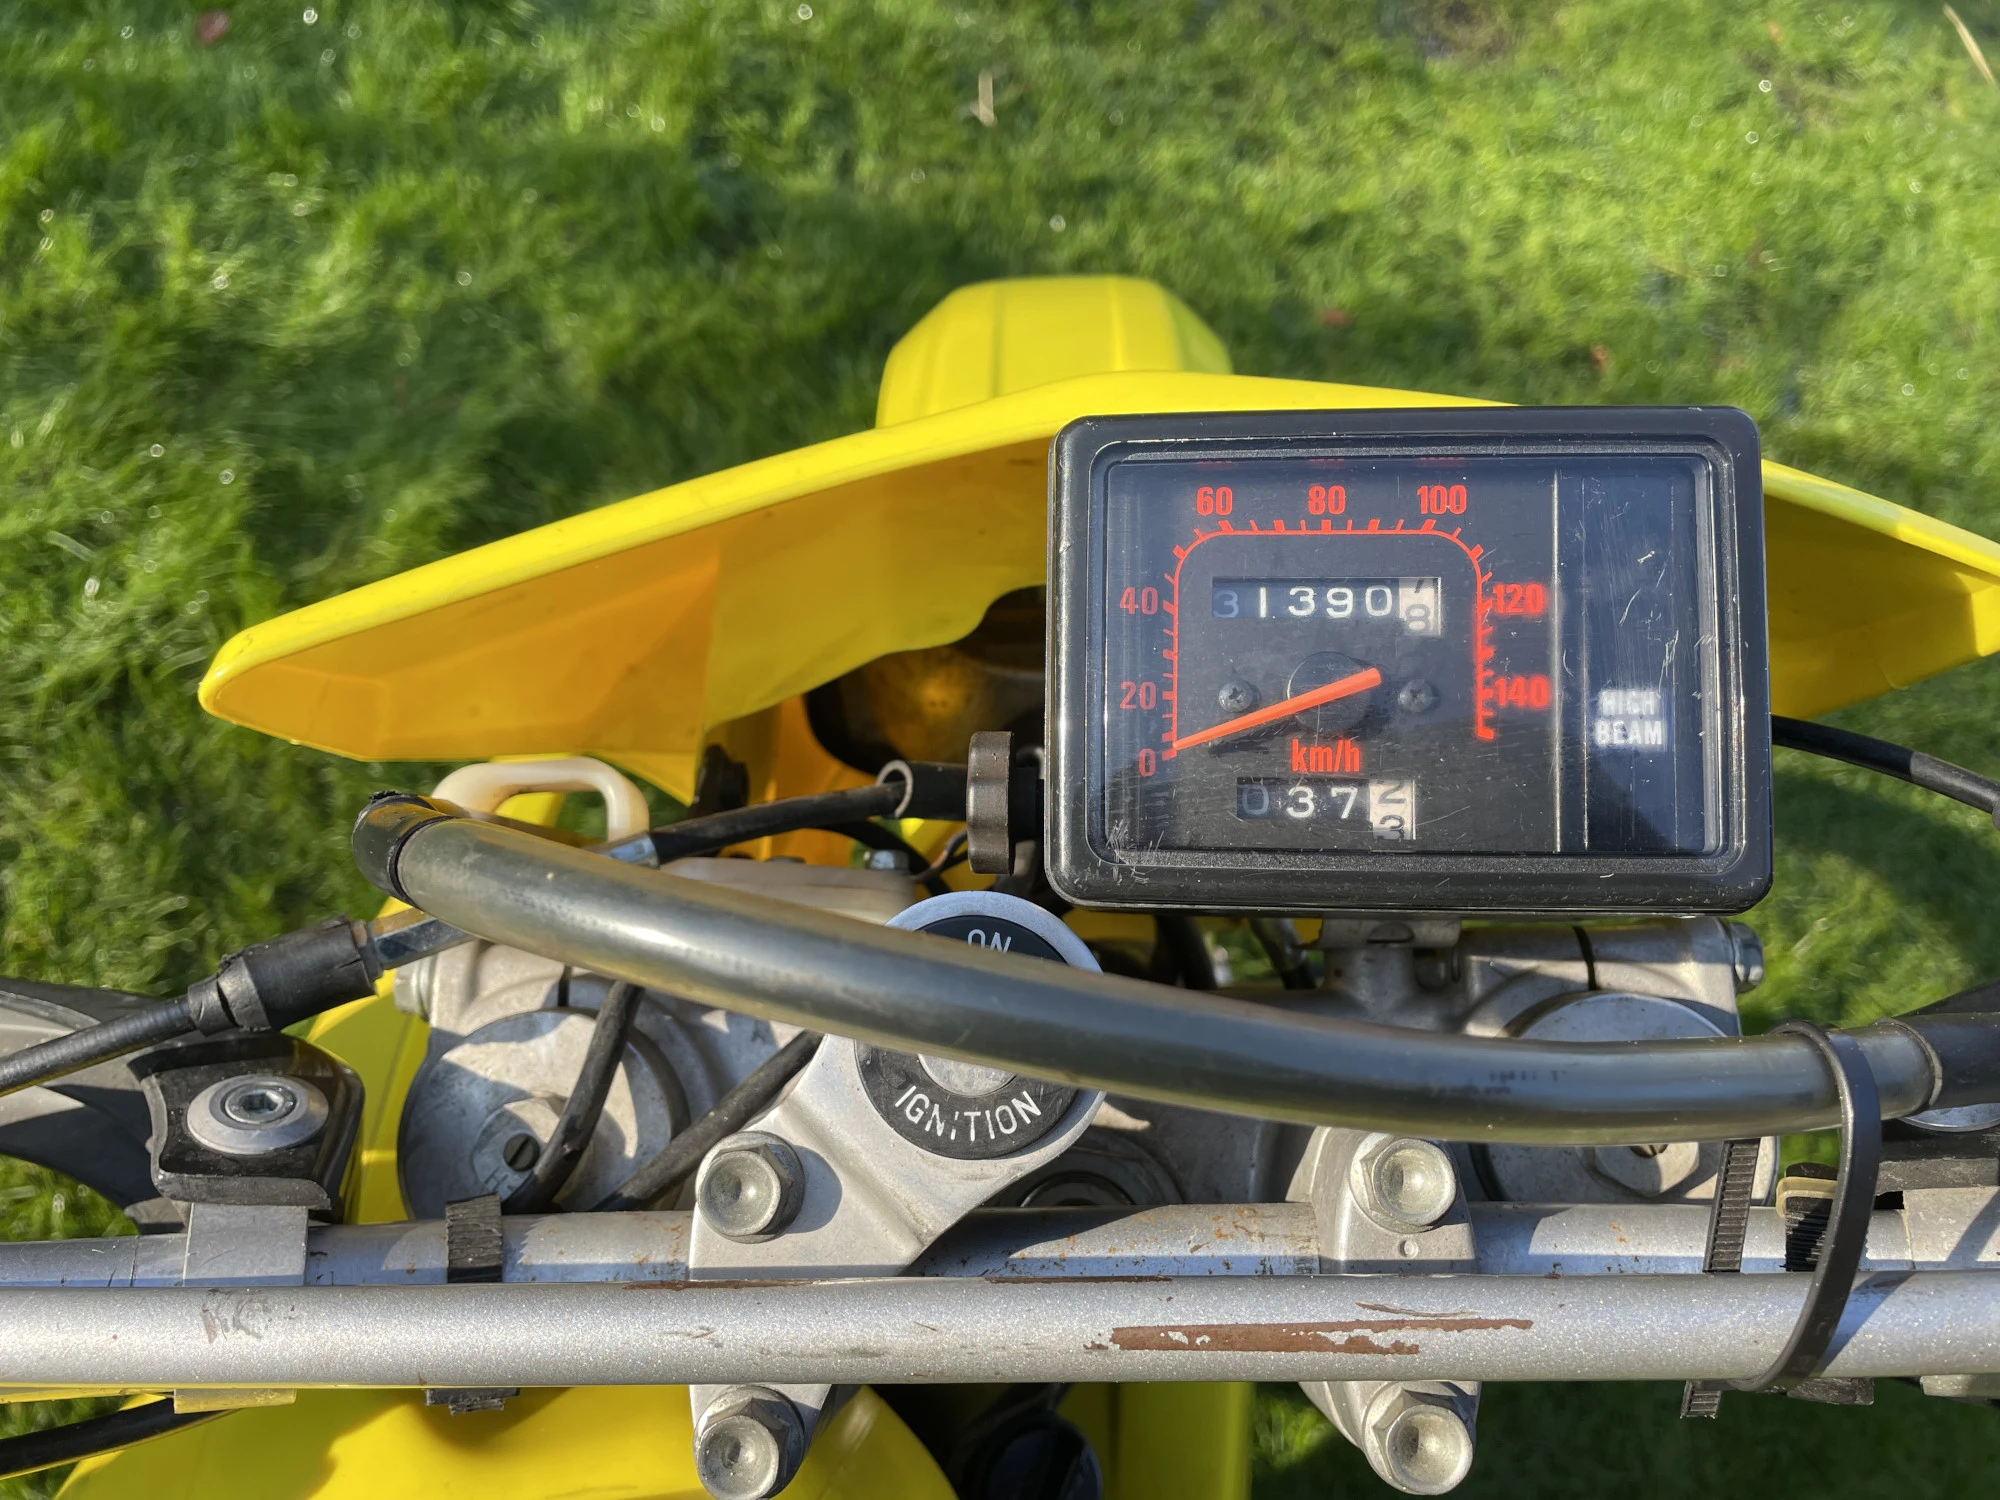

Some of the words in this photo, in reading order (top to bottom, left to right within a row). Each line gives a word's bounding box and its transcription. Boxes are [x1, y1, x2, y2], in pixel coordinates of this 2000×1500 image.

[1196, 486, 1233, 516] 60
[1307, 485, 1346, 515] 80
[1416, 484, 1467, 514] 100
[1119, 586, 1159, 615] 40
[1493, 584, 1545, 616] 120
[1119, 680, 1157, 710] 20
[1495, 675, 1549, 709] 140
[1600, 689, 1657, 716] HIGH
[1596, 719, 1663, 746] BEAM
[1138, 748, 1157, 777] 0
[1290, 737, 1361, 773] km/h
[894, 1084, 1042, 1142] IGNITION
